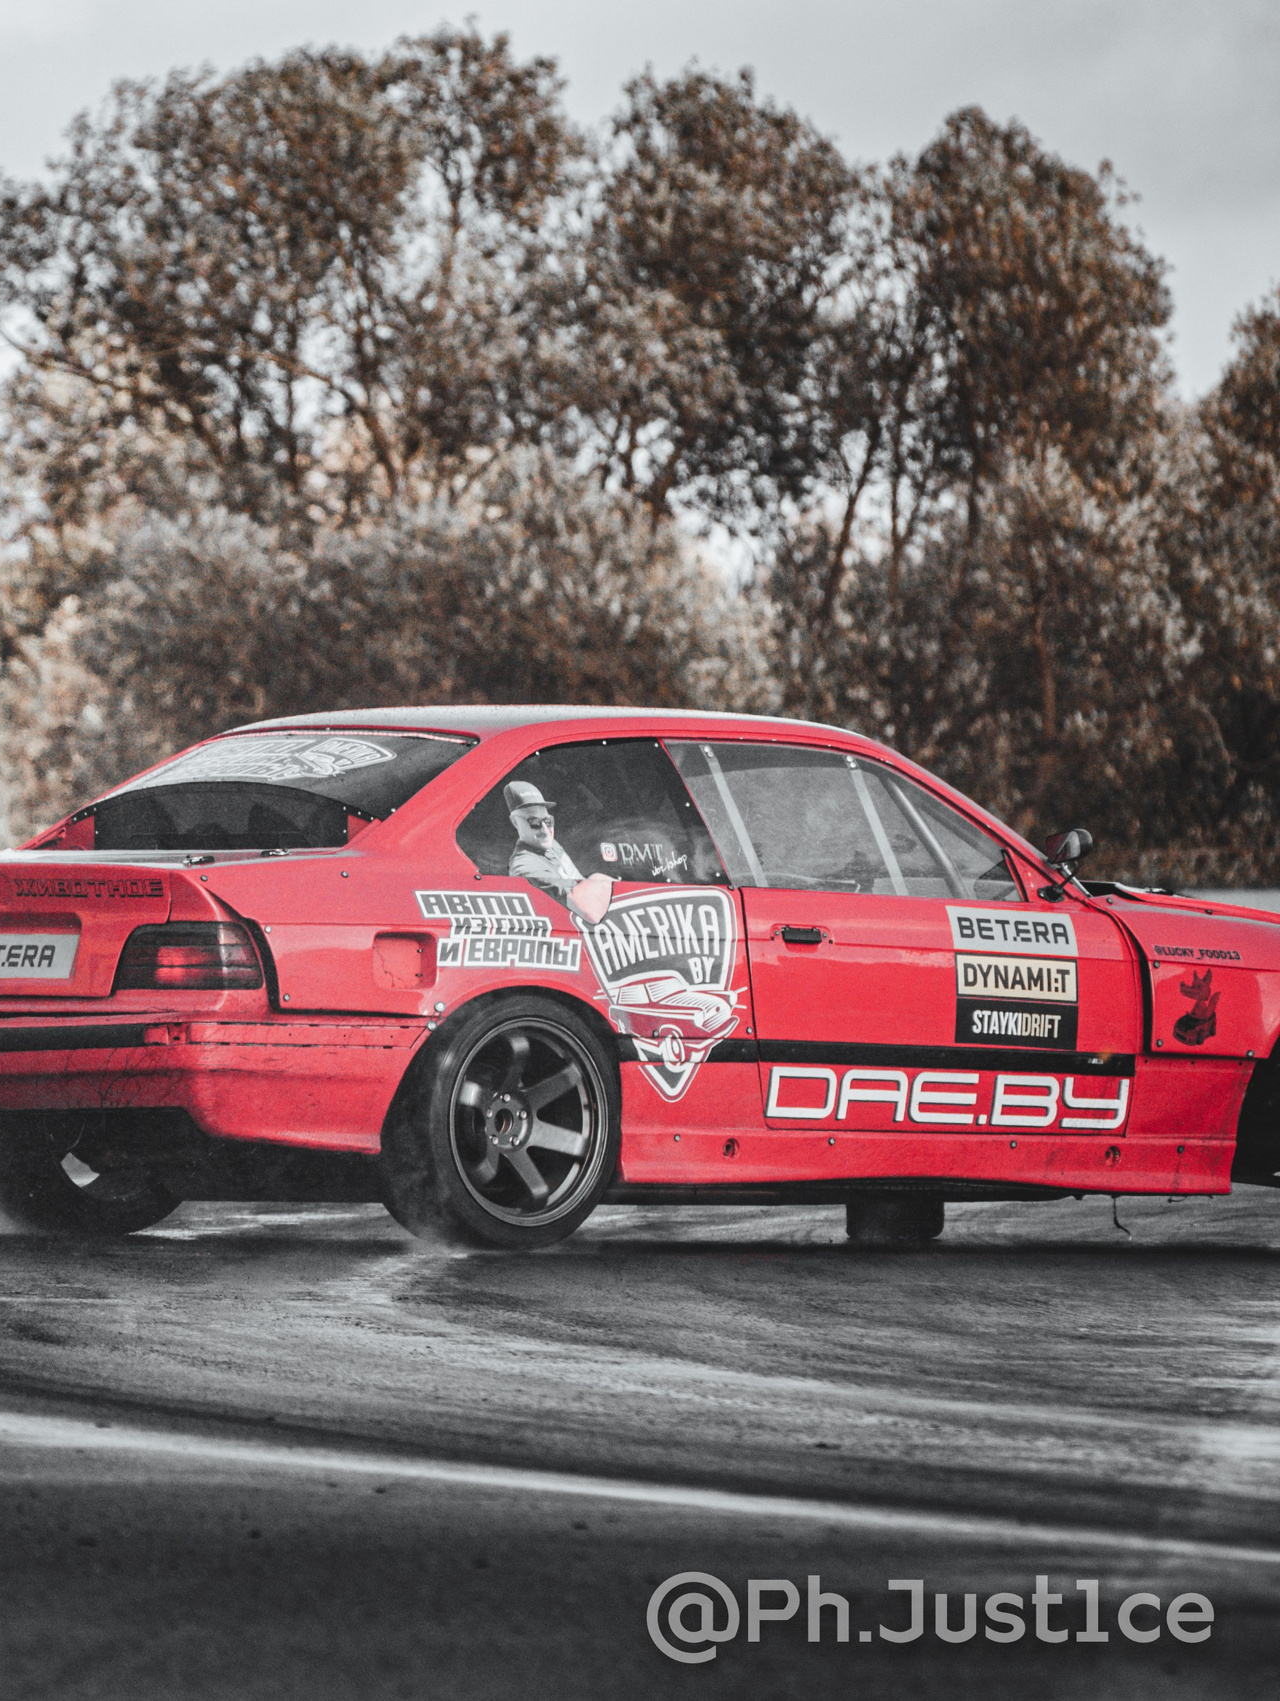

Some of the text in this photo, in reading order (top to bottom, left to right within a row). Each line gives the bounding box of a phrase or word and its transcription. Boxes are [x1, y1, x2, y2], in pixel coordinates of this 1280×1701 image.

[14, 878, 165, 898] ЖИВОТНОЕ
[452, 917, 550, 938] ИЗ США
[594, 903, 720, 975] AMERIKA
[438, 937, 579, 968] И ЕВРОПЫ
[688, 957, 715, 984] BY
[766, 1066, 1130, 1129] DAE.BY
